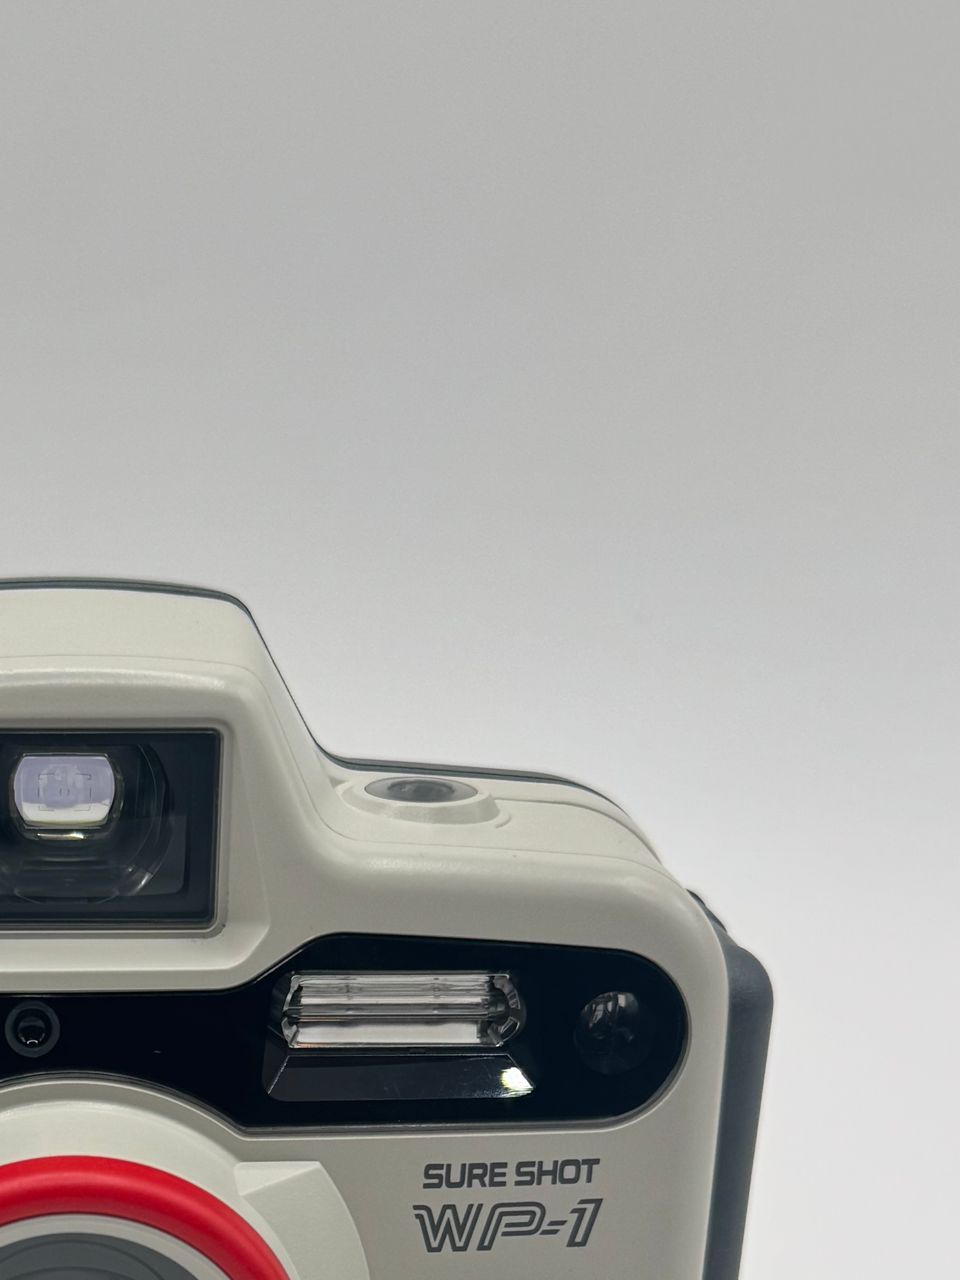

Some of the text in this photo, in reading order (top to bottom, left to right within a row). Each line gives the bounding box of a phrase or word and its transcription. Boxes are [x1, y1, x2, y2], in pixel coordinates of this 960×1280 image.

[422, 1158, 600, 1189] SURE SHOT
[412, 1198, 604, 1253] WP-1
